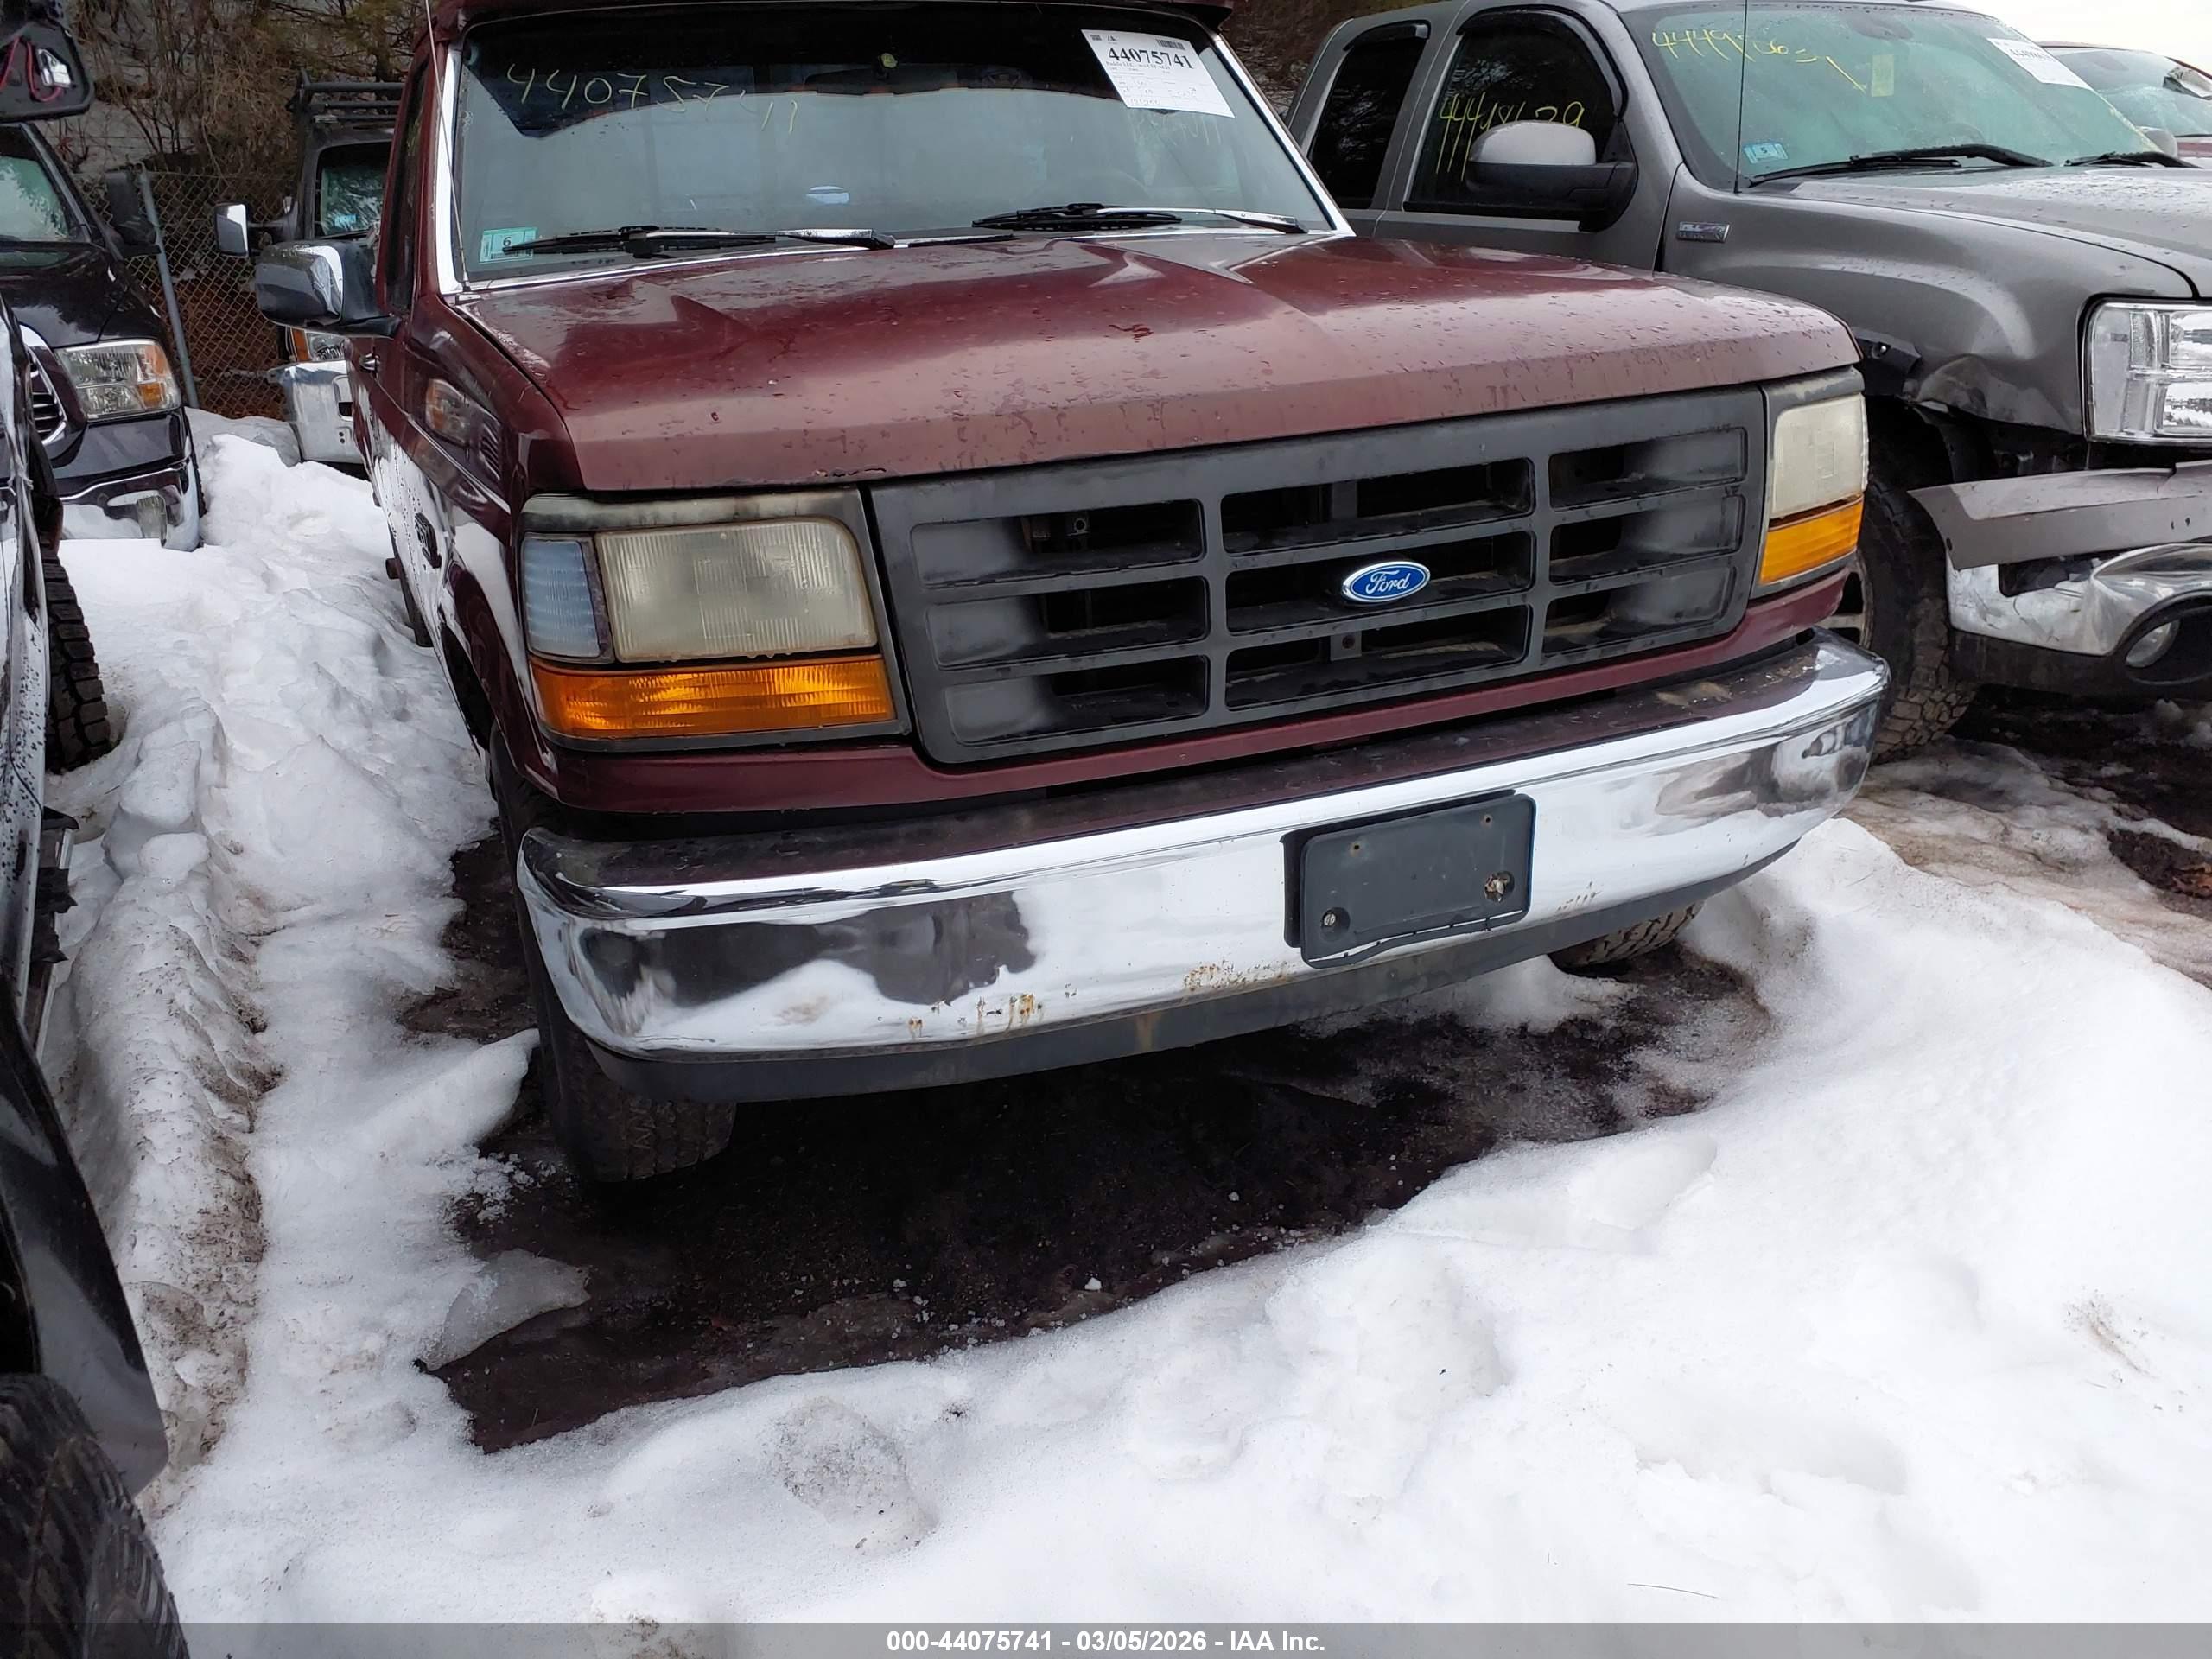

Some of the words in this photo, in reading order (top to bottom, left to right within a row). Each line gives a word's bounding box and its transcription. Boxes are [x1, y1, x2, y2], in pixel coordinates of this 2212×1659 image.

[1108, 47, 1194, 69] 44075741
[503, 236, 512, 247] 6
[1365, 569, 1410, 594] Ford
